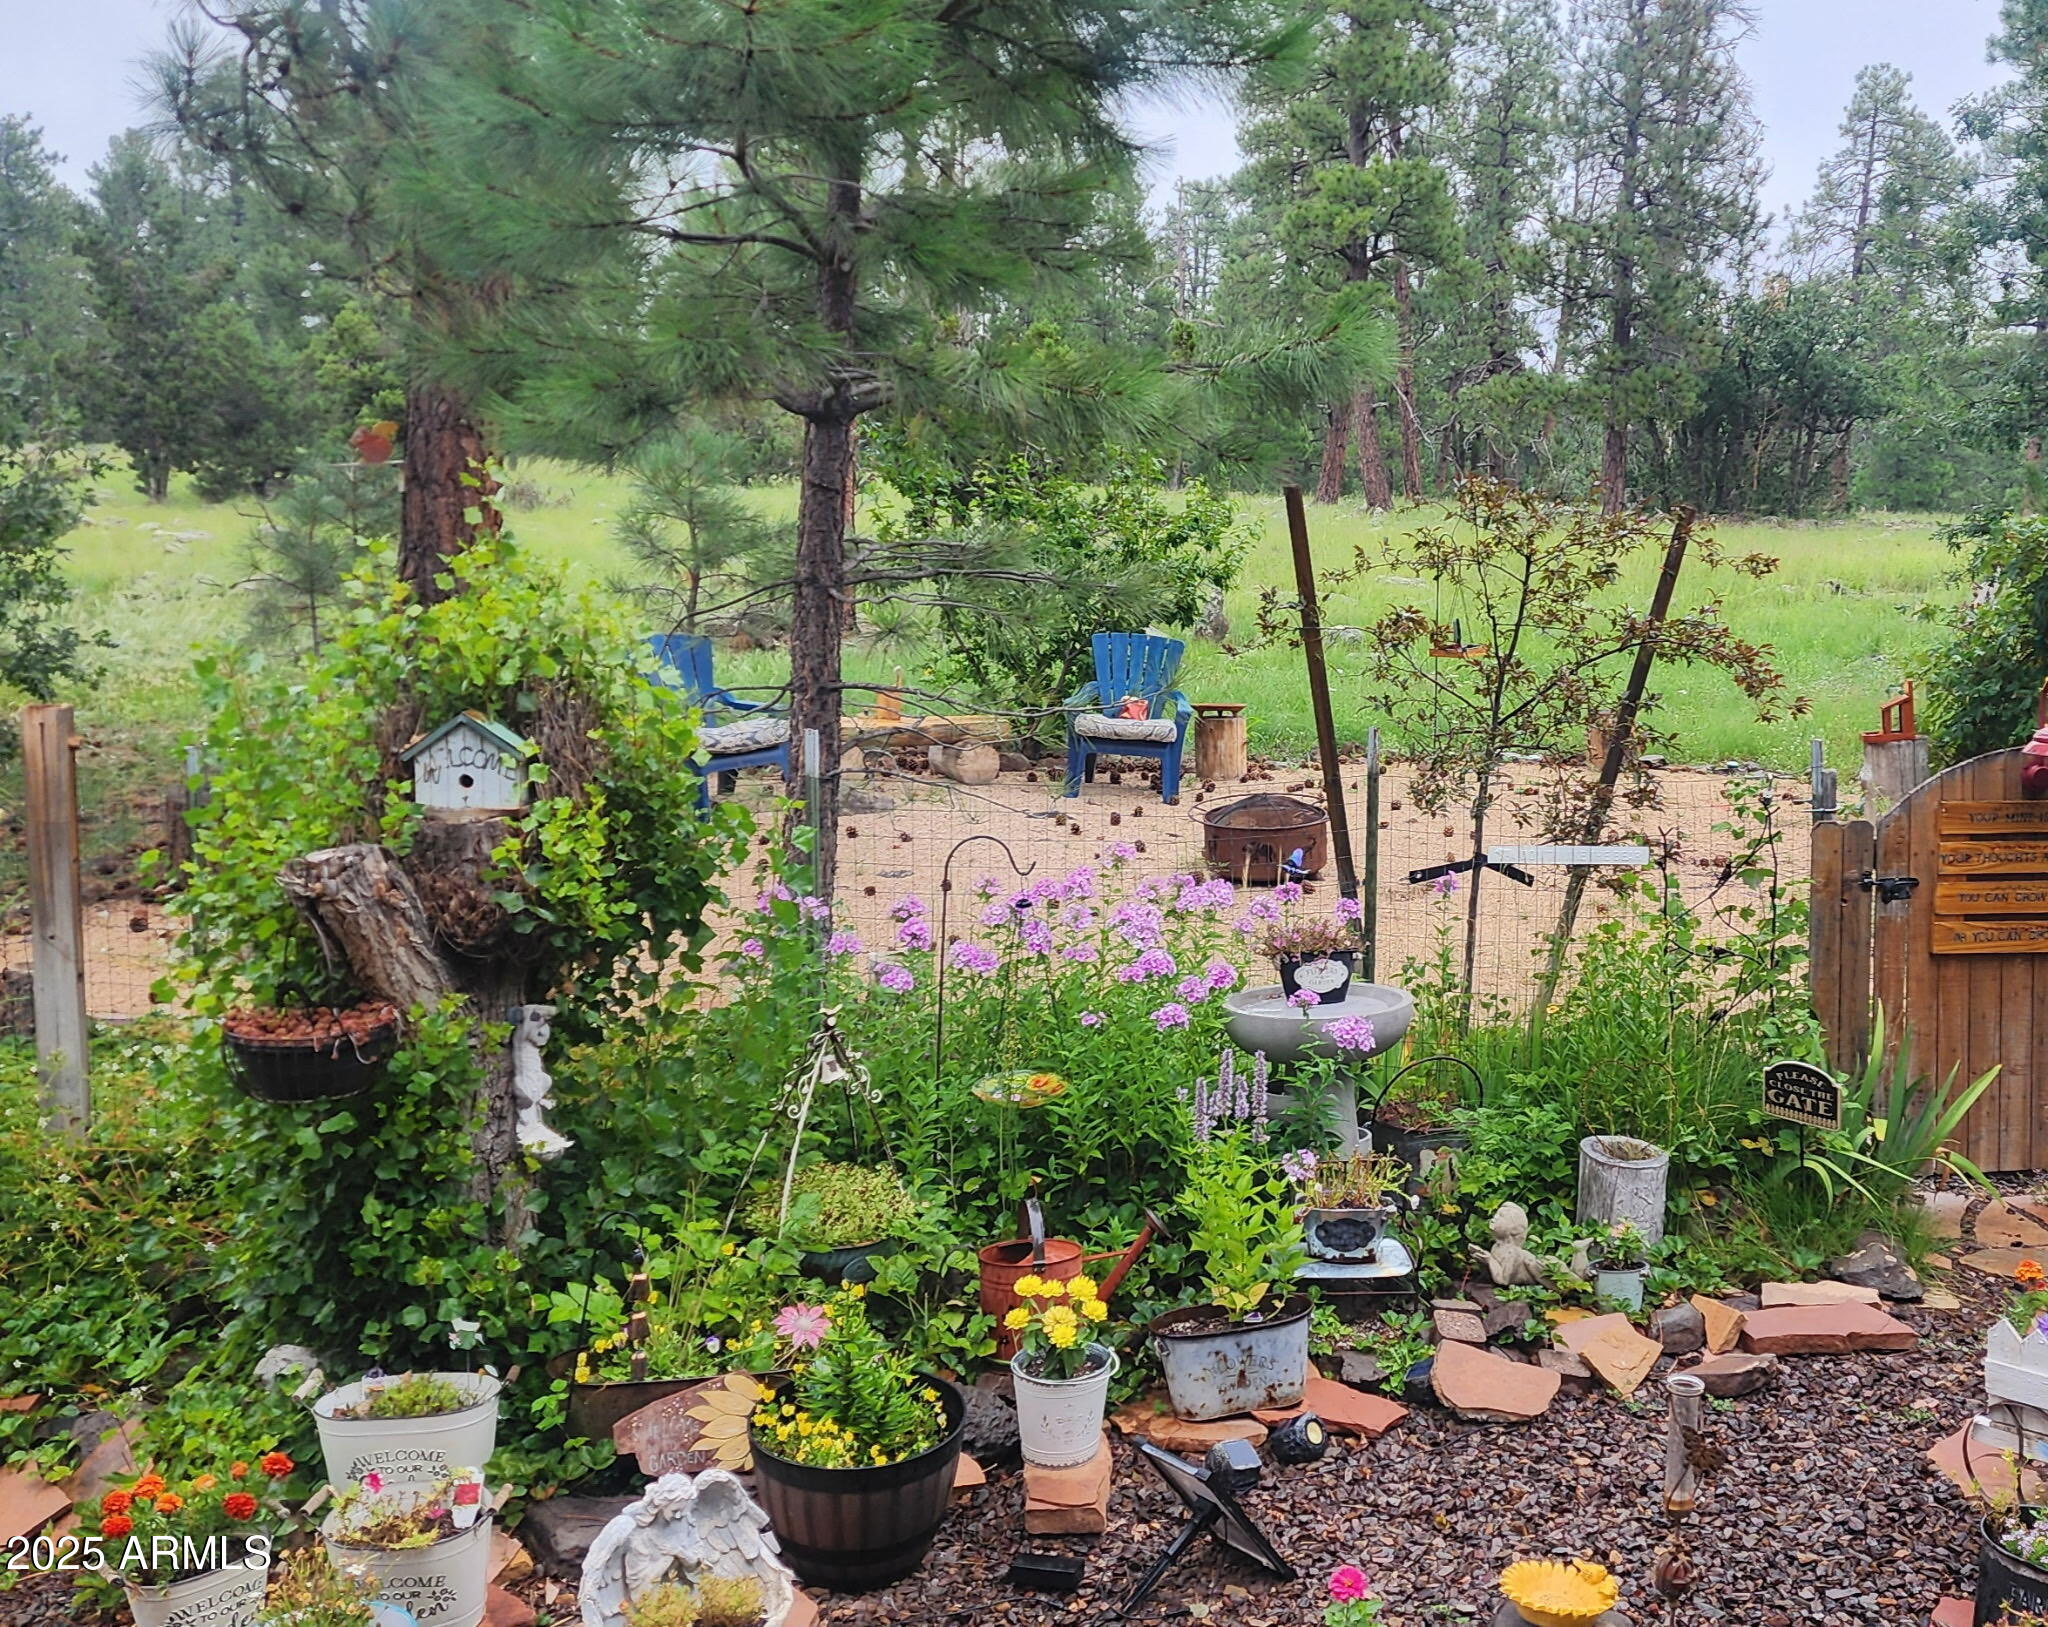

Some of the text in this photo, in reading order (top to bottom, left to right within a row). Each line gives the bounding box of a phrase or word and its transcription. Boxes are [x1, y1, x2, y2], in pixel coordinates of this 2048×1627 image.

[422, 746, 516, 785] WLCOME
[1976, 851, 2036, 864] THOUGHTS
[1984, 892, 2009, 903] CAN
[1972, 930, 1994, 943] YOU
[1998, 931, 2021, 942] CAN
[1775, 1071, 1825, 1090] PLEASE
[1768, 1079, 1834, 1101] CLOSE THE
[1767, 1088, 1833, 1117] GATE
[353, 1450, 446, 1468] WELCOME
[649, 1451, 706, 1472] GARDEN
[378, 1464, 423, 1475] TO OUR
[376, 1591, 421, 1601] O OUR
[201, 1612, 218, 1623] TO
[220, 1599, 247, 1616] OUR
